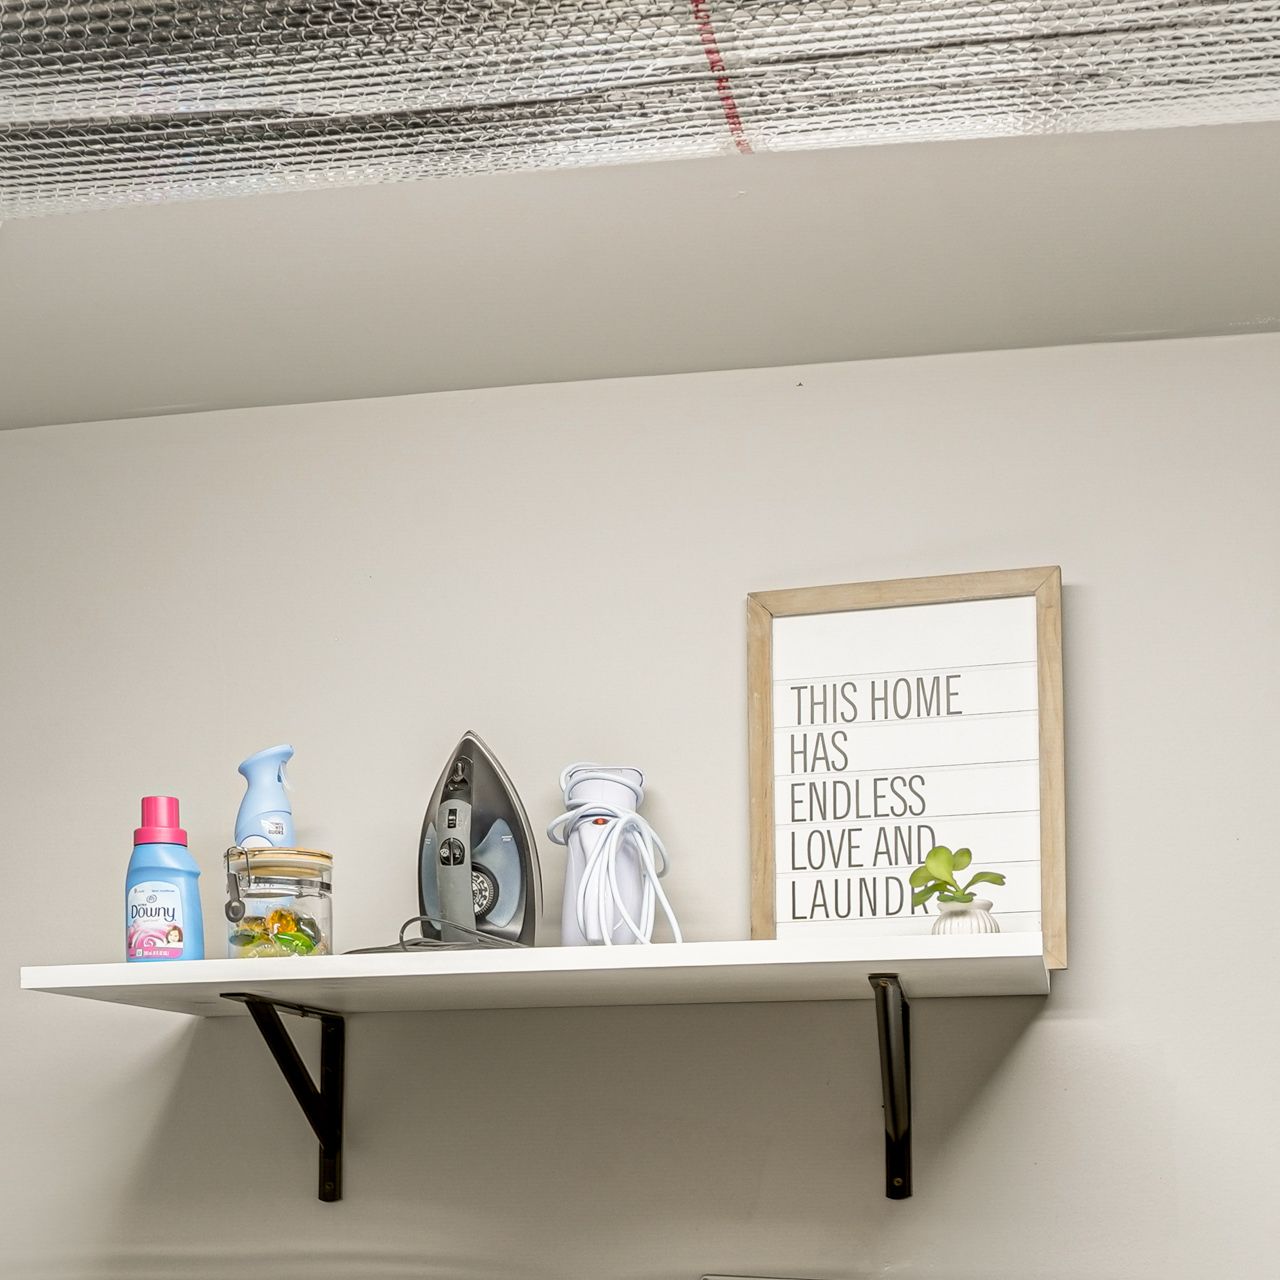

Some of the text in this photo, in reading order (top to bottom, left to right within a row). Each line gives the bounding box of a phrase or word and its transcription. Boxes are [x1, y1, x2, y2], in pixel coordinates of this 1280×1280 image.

[791, 675, 962, 725] THIS HOME
[791, 731, 848, 773] HAS
[791, 775, 926, 822] ENDLESS
[791, 825, 936, 870] LOVE AND
[131, 904, 176, 922] Downy
